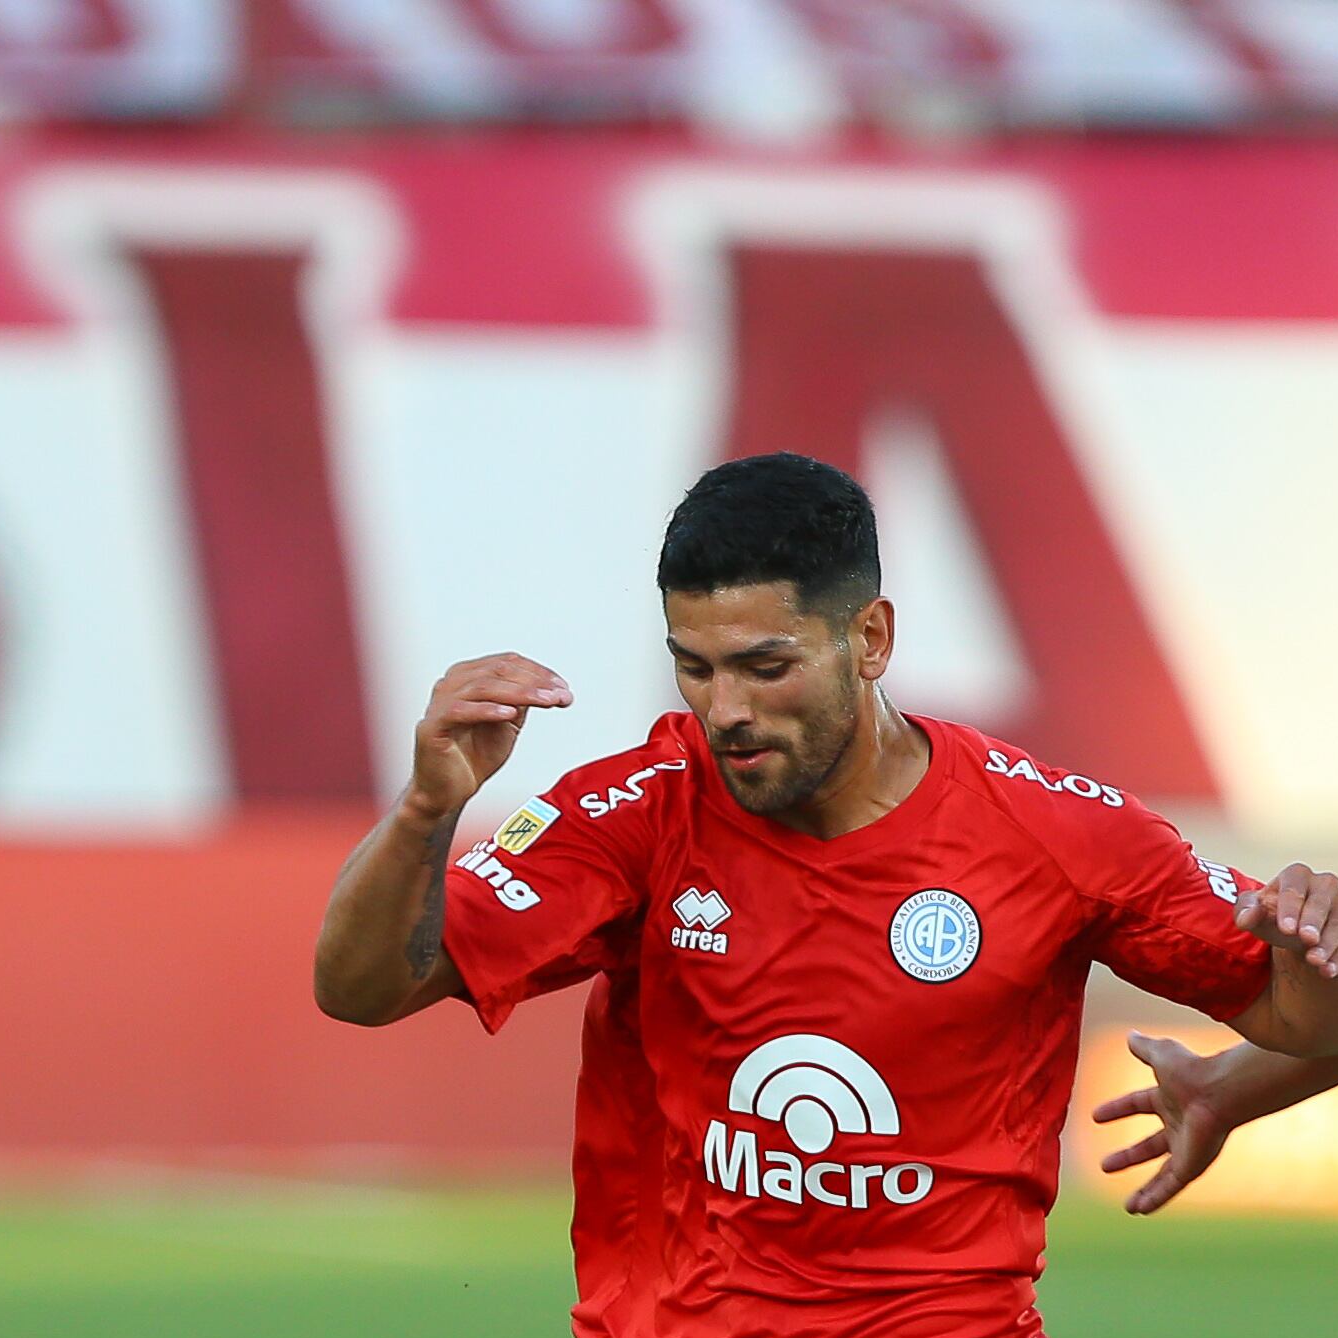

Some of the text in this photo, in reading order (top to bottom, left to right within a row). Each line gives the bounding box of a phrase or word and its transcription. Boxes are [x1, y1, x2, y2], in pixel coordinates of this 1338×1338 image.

[671, 926, 728, 954] errea
[892, 892, 977, 954] CLUB ATLETICO BELGRANO
[907, 962, 961, 979] CORDOBA
[704, 1119, 935, 1209] Macro
